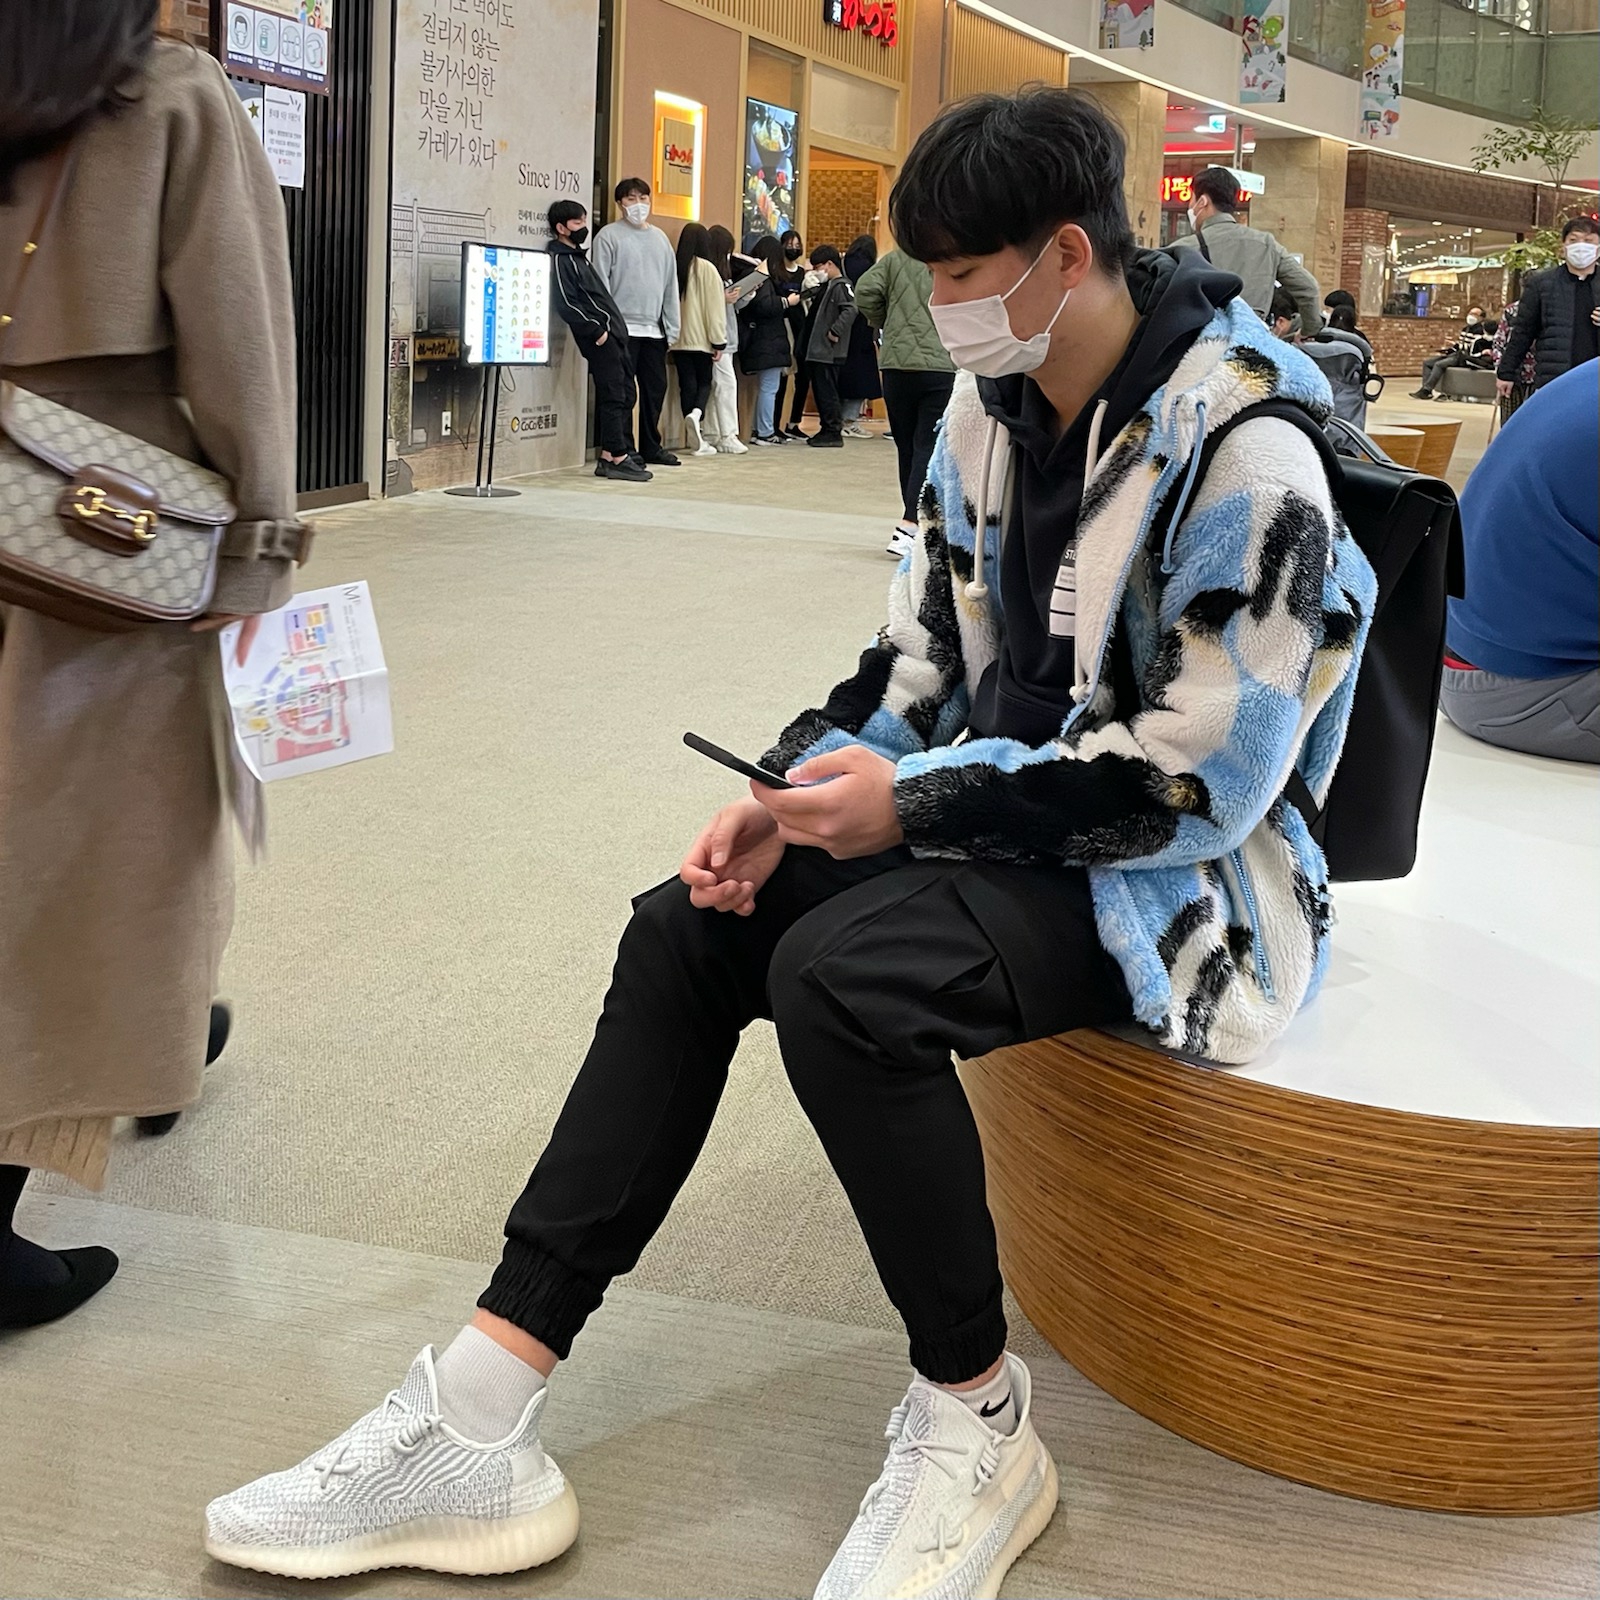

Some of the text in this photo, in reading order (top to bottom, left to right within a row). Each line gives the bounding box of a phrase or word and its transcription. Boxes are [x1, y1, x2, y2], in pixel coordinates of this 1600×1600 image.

[421, 12, 500, 62] 질리지 않는
[420, 50, 496, 97] 불가사의한
[419, 88, 483, 130] 맛을 지닌
[418, 126, 465, 165] 카레가
[518, 162, 580, 194] Since 1978
